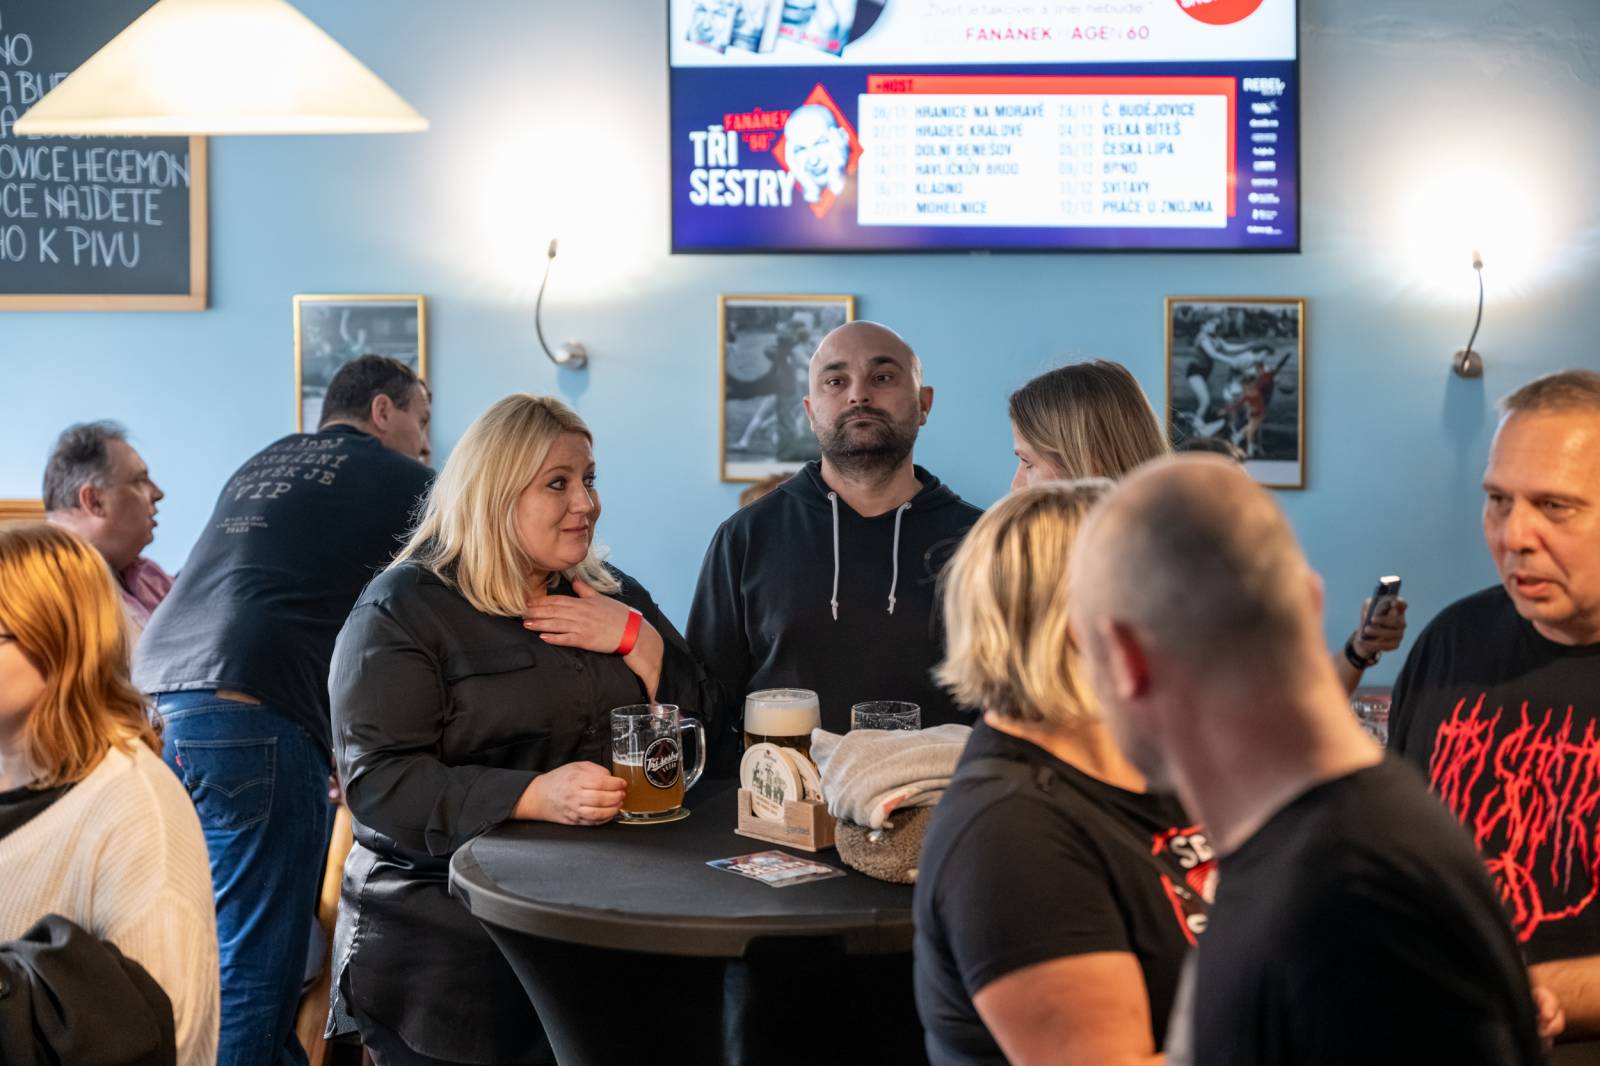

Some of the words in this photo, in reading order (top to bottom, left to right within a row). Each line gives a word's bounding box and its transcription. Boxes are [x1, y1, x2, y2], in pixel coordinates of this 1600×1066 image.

[689, 124, 738, 167] TŘI
[73, 147, 190, 188] HEGEMON
[688, 168, 797, 207] SESTRY
[44, 183, 163, 226] NAJDETE
[39, 227, 60, 264] K
[64, 225, 140, 268] PIVU
[234, 481, 292, 501] VIP
[304, 468, 336, 486] JE
